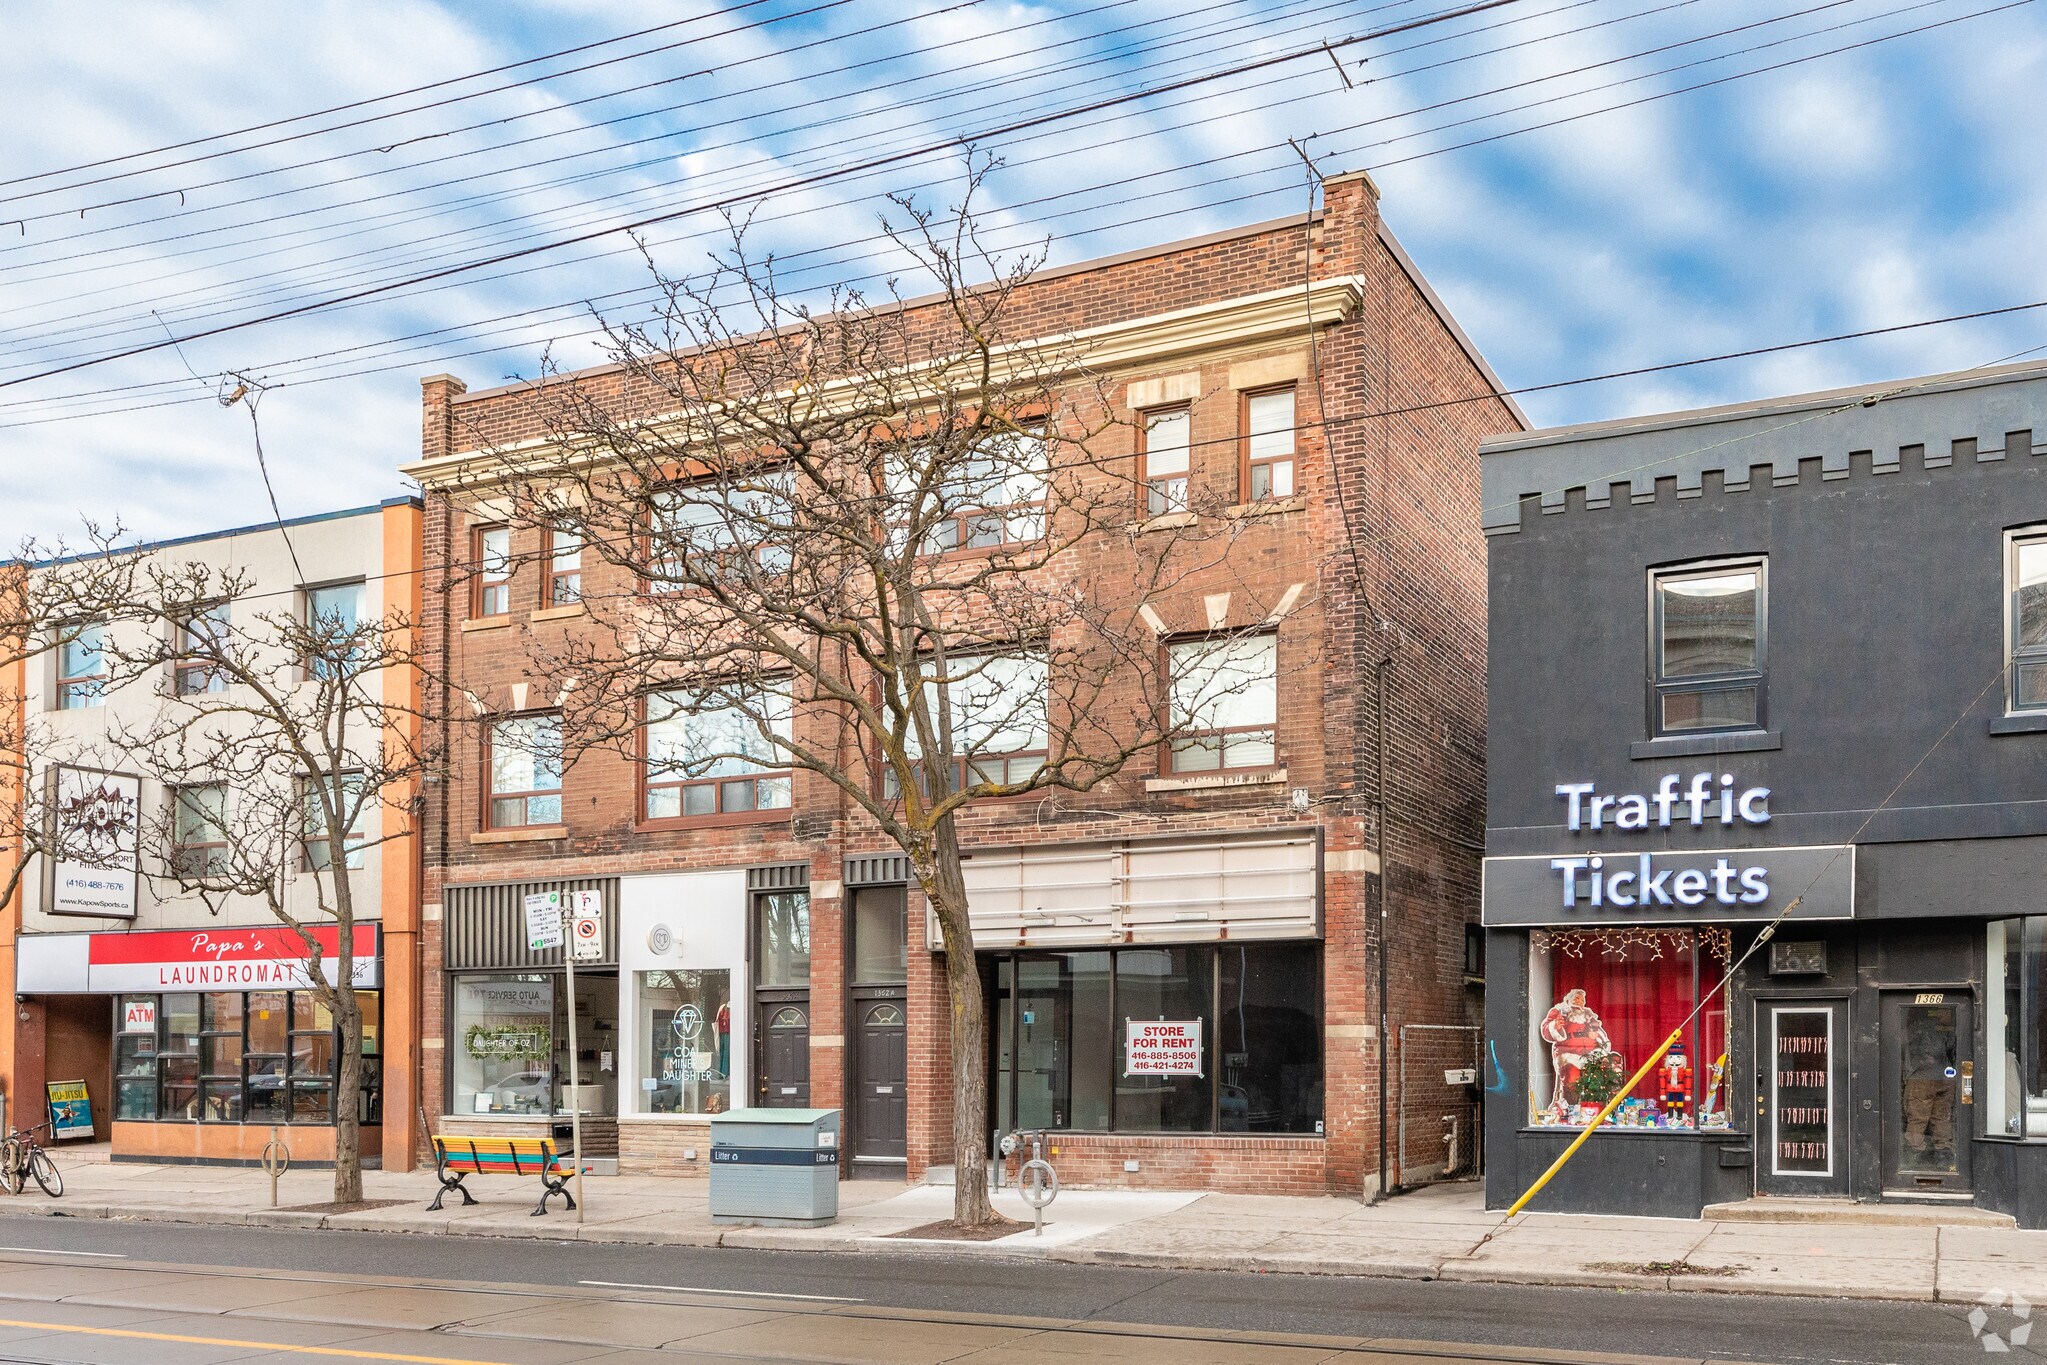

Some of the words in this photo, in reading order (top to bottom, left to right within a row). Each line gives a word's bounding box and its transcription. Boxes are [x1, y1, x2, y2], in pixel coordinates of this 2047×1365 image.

[1555, 772, 1771, 831] Traffic
[79, 862, 113, 872] FITNESS
[1551, 852, 1770, 907] Tickets
[66, 879, 87, 889] (416)
[87, 880, 124, 891] 488-7676
[59, 899, 129, 909] www.KapowSports.ca
[543, 937, 557, 945] 5547
[190, 933, 264, 960] Papa's
[160, 964, 295, 985] LAUNDROMAT
[1918, 994, 1943, 1004] 1366
[127, 1009, 154, 1022] ATM
[1144, 1026, 1185, 1036] STORE
[473, 1039, 507, 1047] DAUGHTER
[508, 1039, 519, 1047] OF
[520, 1039, 531, 1047] OZ
[1133, 1038, 1158, 1048] FOR
[1162, 1038, 1195, 1048] RENT
[1131, 1052, 1197, 1060] 416-885-8506
[1134, 1061, 1194, 1069] 416-421-4274
[662, 1070, 712, 1081] DAUGHTER
[714, 1151, 731, 1160] Litter
[816, 1153, 829, 1162] Litter
